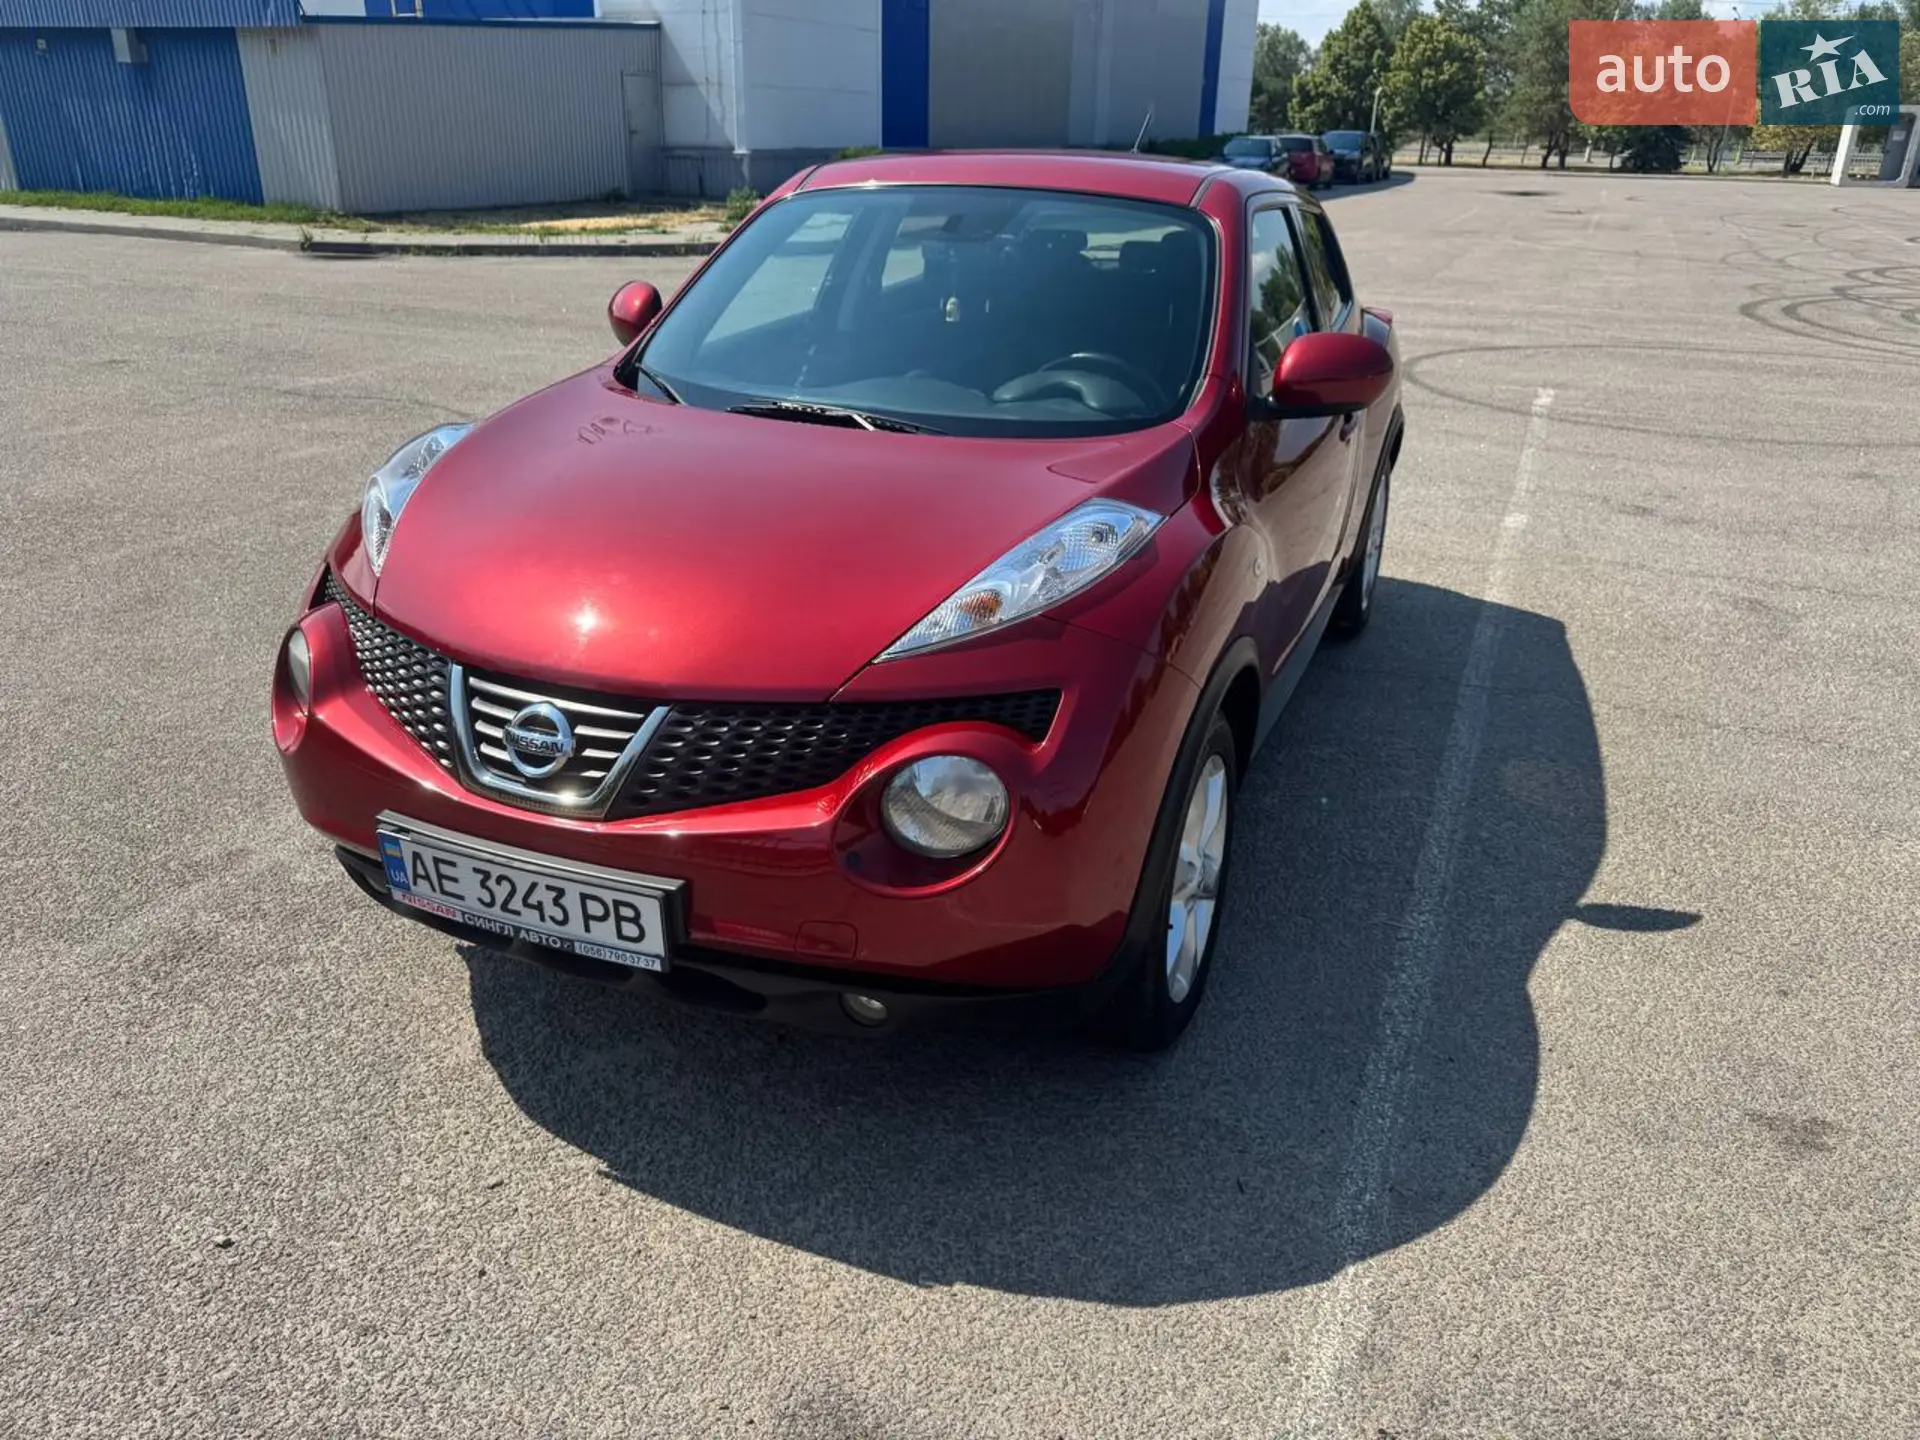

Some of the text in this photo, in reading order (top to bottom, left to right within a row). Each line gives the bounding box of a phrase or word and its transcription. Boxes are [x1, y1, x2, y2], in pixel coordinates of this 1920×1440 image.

[505, 731, 564, 753] NISSAN
[391, 870, 408, 884] UA
[401, 894, 457, 917] NISSAN
[411, 851, 646, 944] AE 3243 PB
